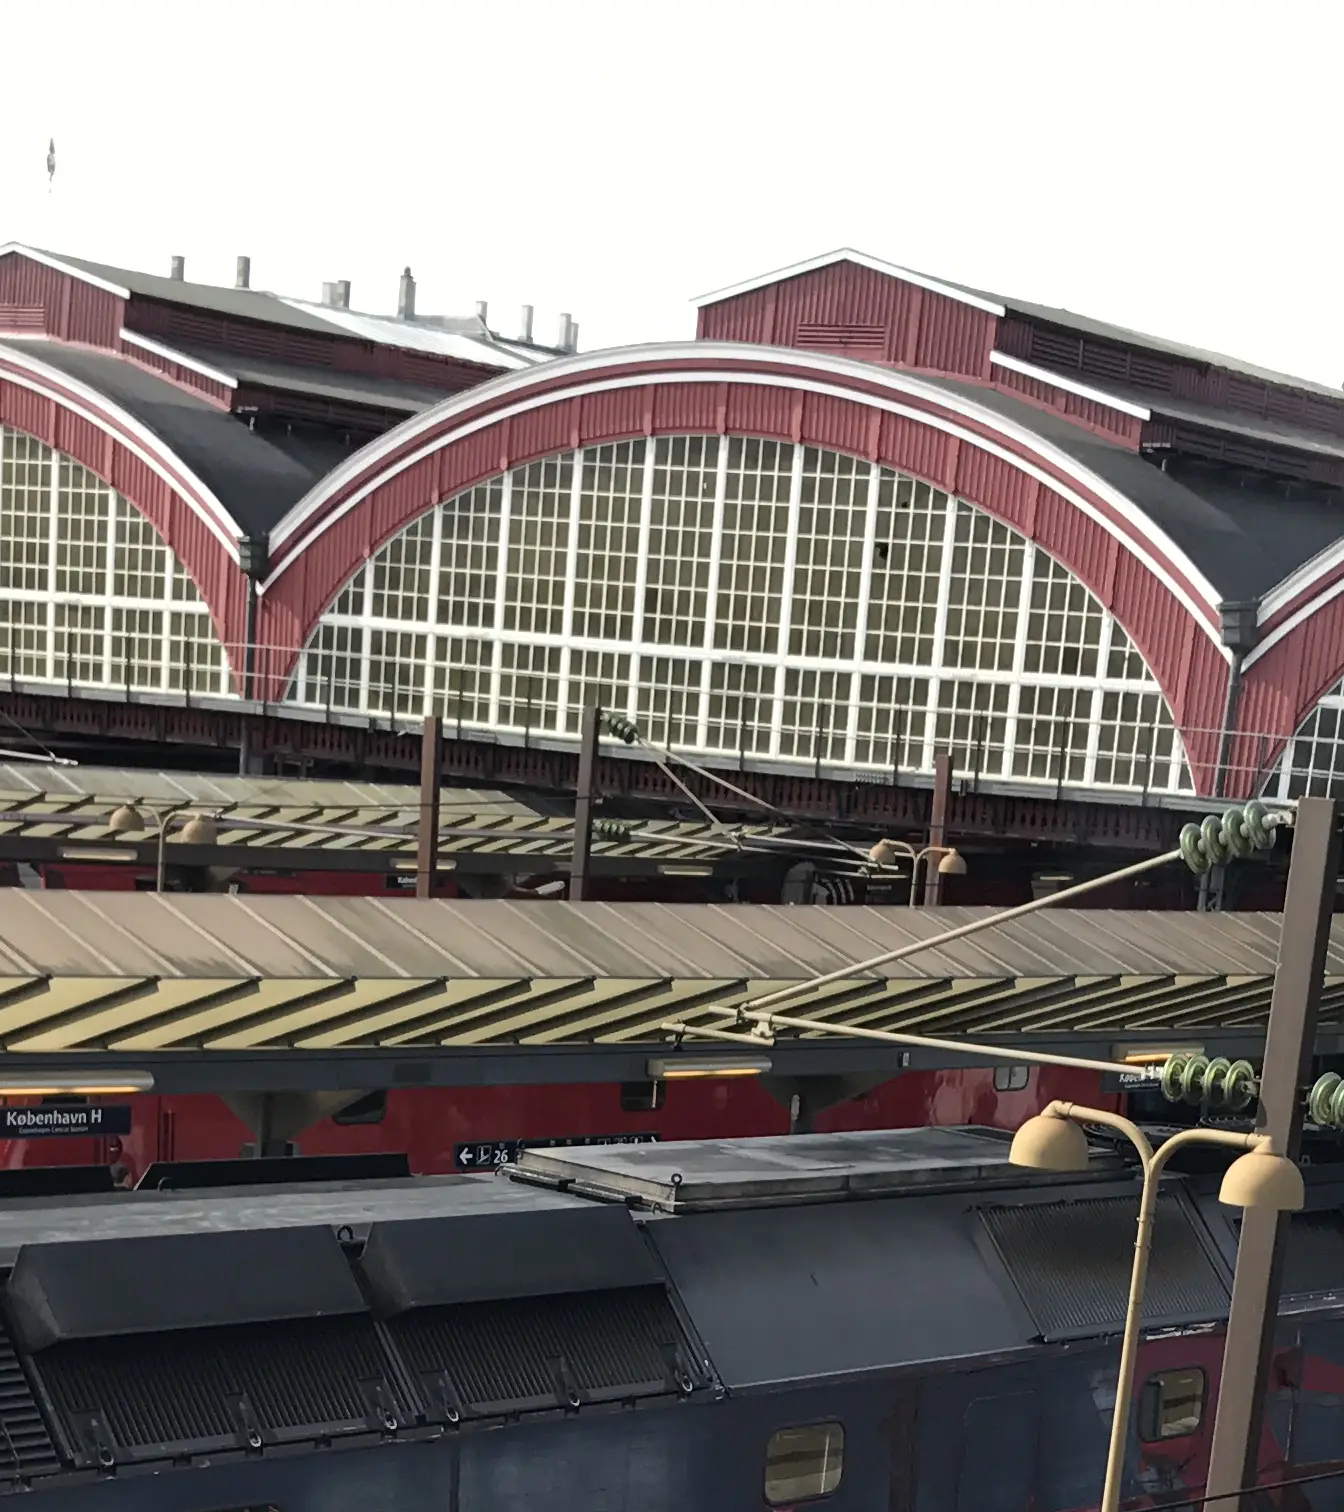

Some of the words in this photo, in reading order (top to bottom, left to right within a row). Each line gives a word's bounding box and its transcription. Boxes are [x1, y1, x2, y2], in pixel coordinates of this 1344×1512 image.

[7, 1109, 87, 1126] København
[91, 1109, 102, 1123] H
[493, 1150, 508, 1163] 26
